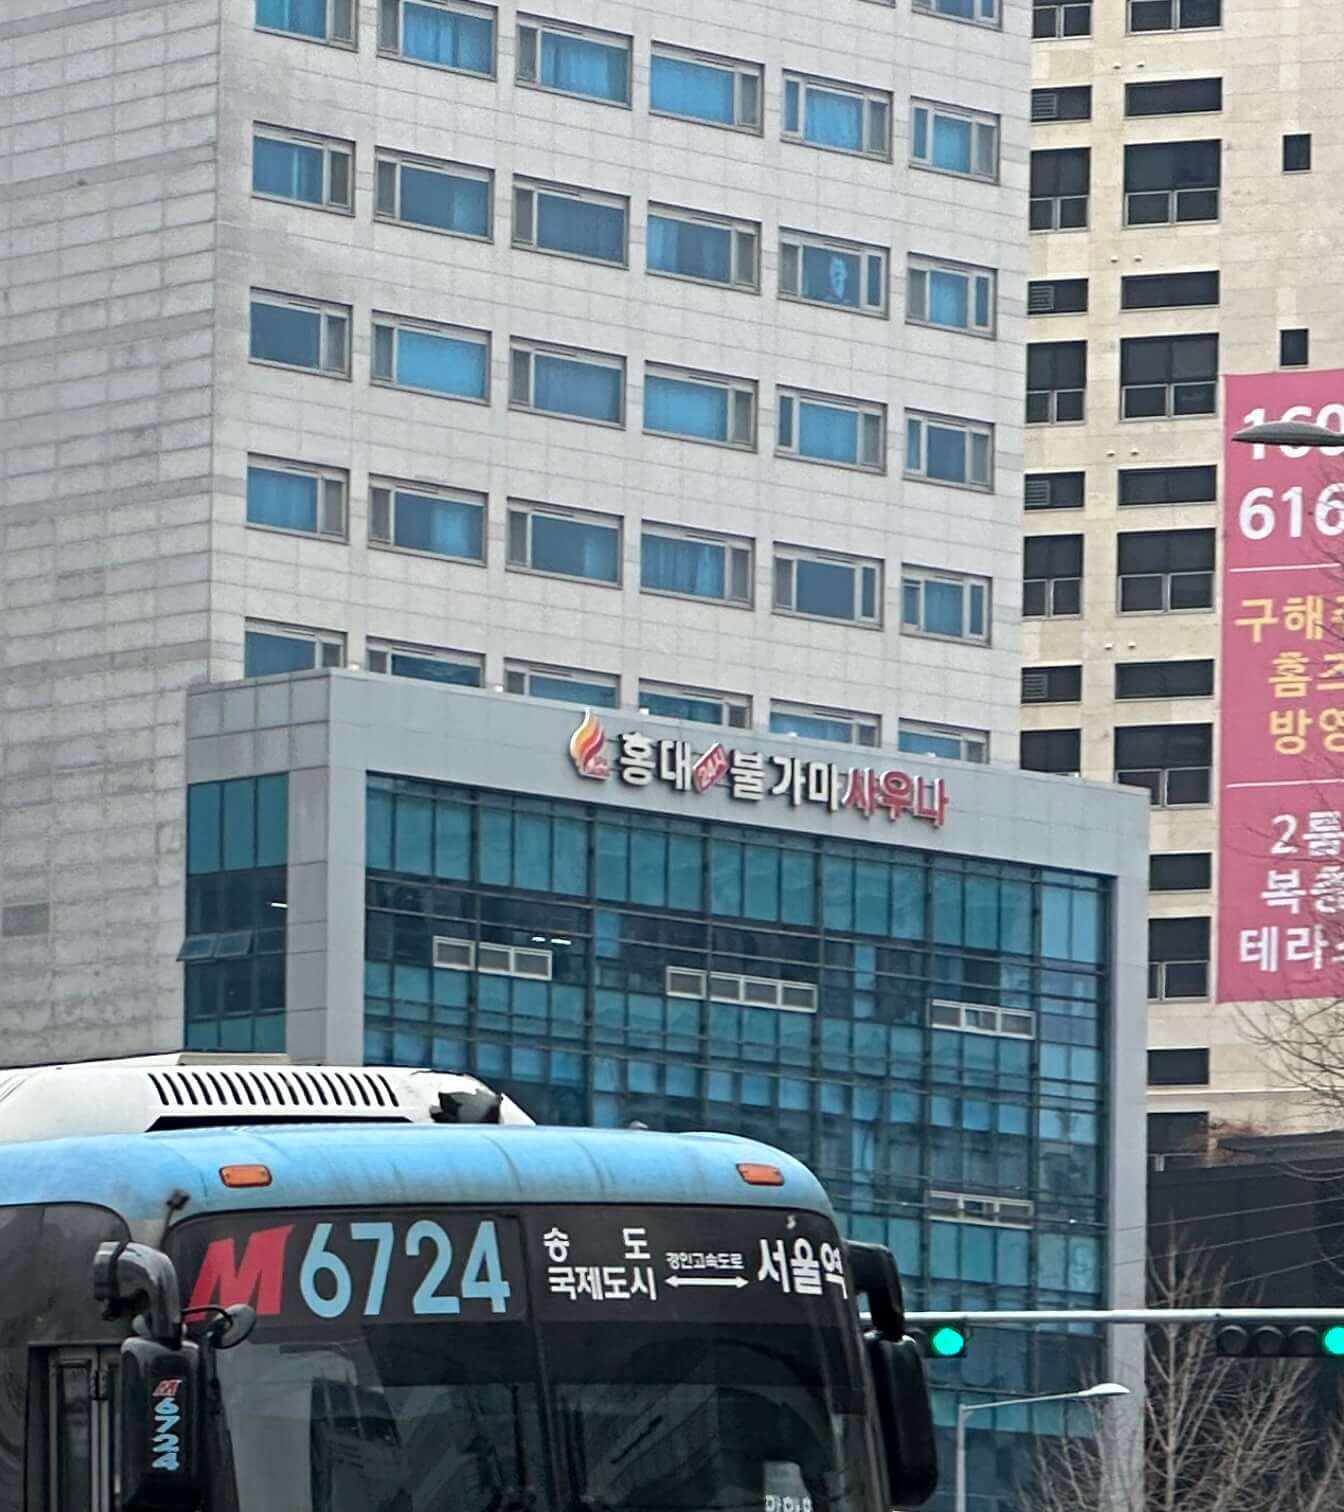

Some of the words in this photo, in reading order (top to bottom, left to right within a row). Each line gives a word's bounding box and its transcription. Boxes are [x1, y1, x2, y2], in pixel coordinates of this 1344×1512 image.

[619, 731, 692, 792] 홍대
[547, 1265, 658, 1300] 국제도시
[758, 1237, 849, 1300] 서울역
